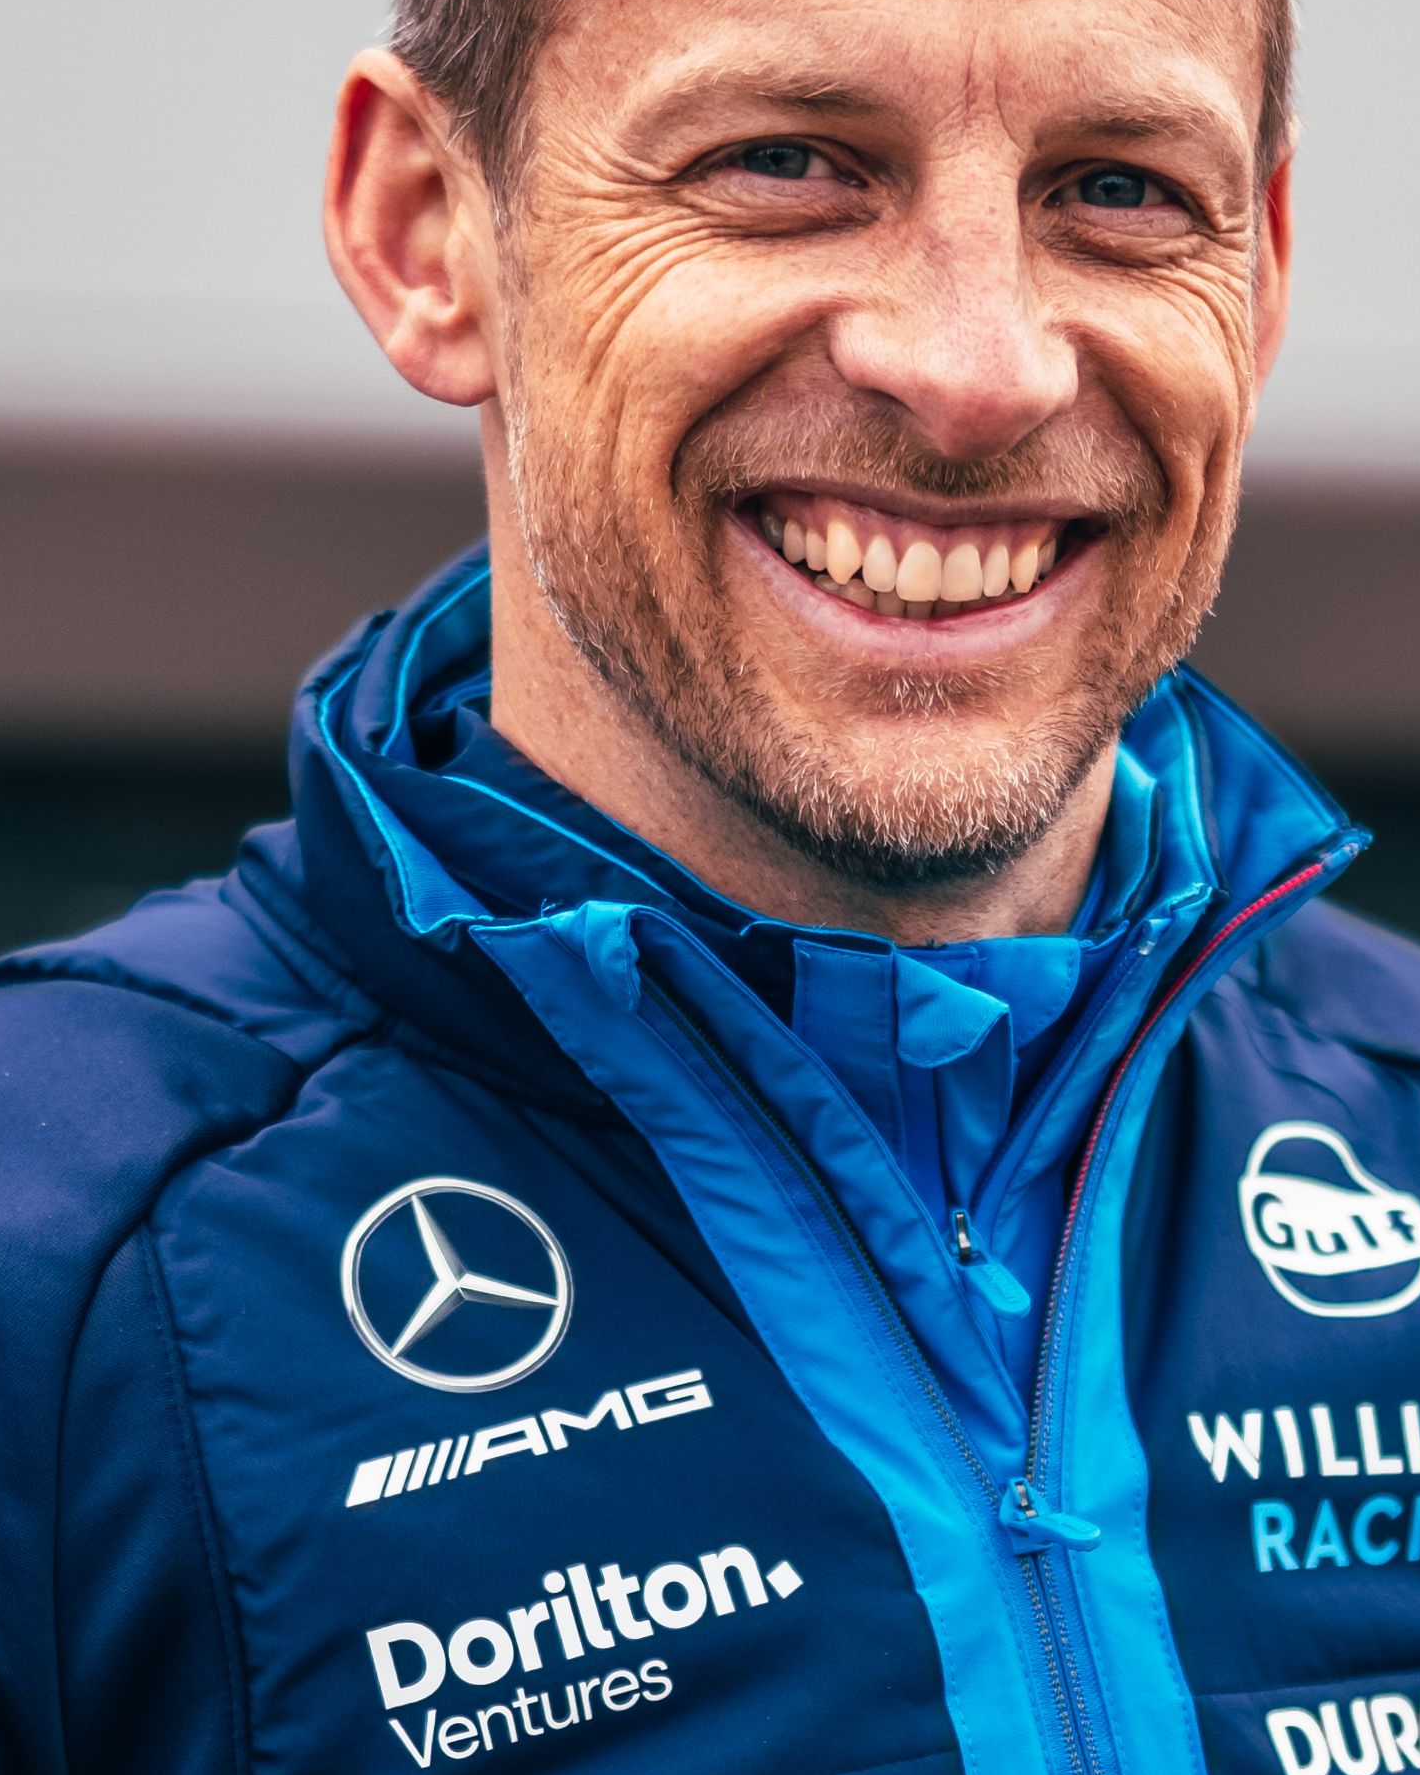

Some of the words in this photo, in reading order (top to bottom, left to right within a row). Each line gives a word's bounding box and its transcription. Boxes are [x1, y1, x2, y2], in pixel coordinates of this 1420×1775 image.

[1250, 1190, 1417, 1257] Gulf
[462, 1368, 714, 1476] AMG
[387, 1658, 674, 1770] Ventures
